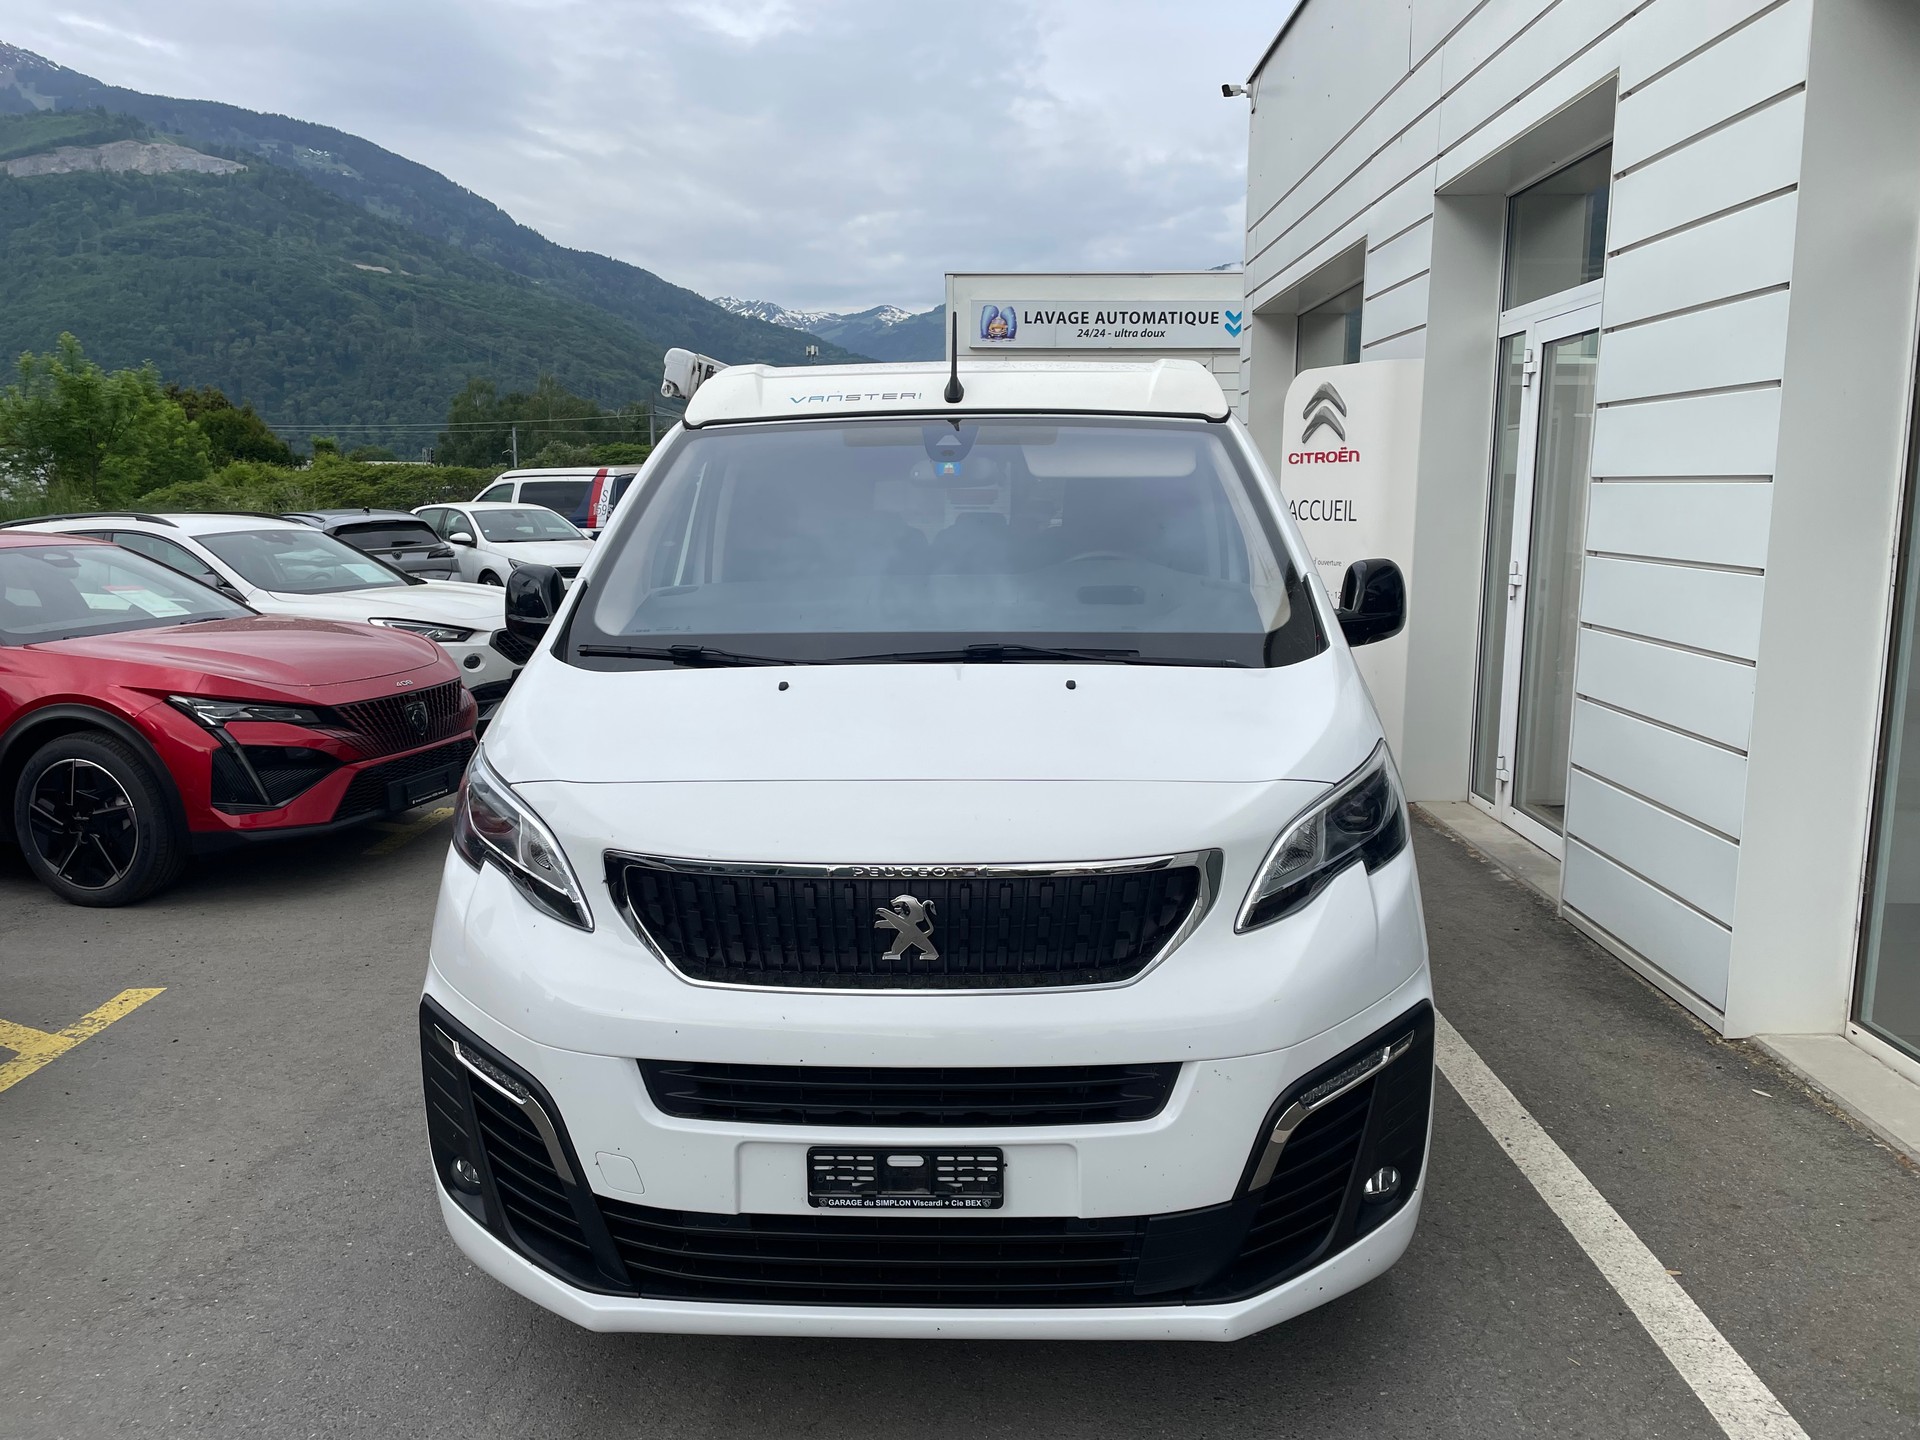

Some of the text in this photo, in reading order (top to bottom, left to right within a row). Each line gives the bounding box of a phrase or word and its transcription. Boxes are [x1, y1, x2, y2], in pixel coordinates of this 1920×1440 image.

[1024, 311, 1219, 326] LAVAGE AUTOMATIQUE
[1077, 328, 1106, 338] 24/24
[1114, 328, 1138, 338] ultra
[1140, 328, 1166, 338] doux
[1289, 500, 1357, 522] ACCUEIL
[396, 679, 414, 687] 408
[852, 866, 962, 878] PEUGEOT
[828, 1199, 863, 1207] GARAGE
[864, 1199, 874, 1207] du
[875, 1199, 912, 1207] SIMPLON
[913, 1199, 943, 1207] Viscardi
